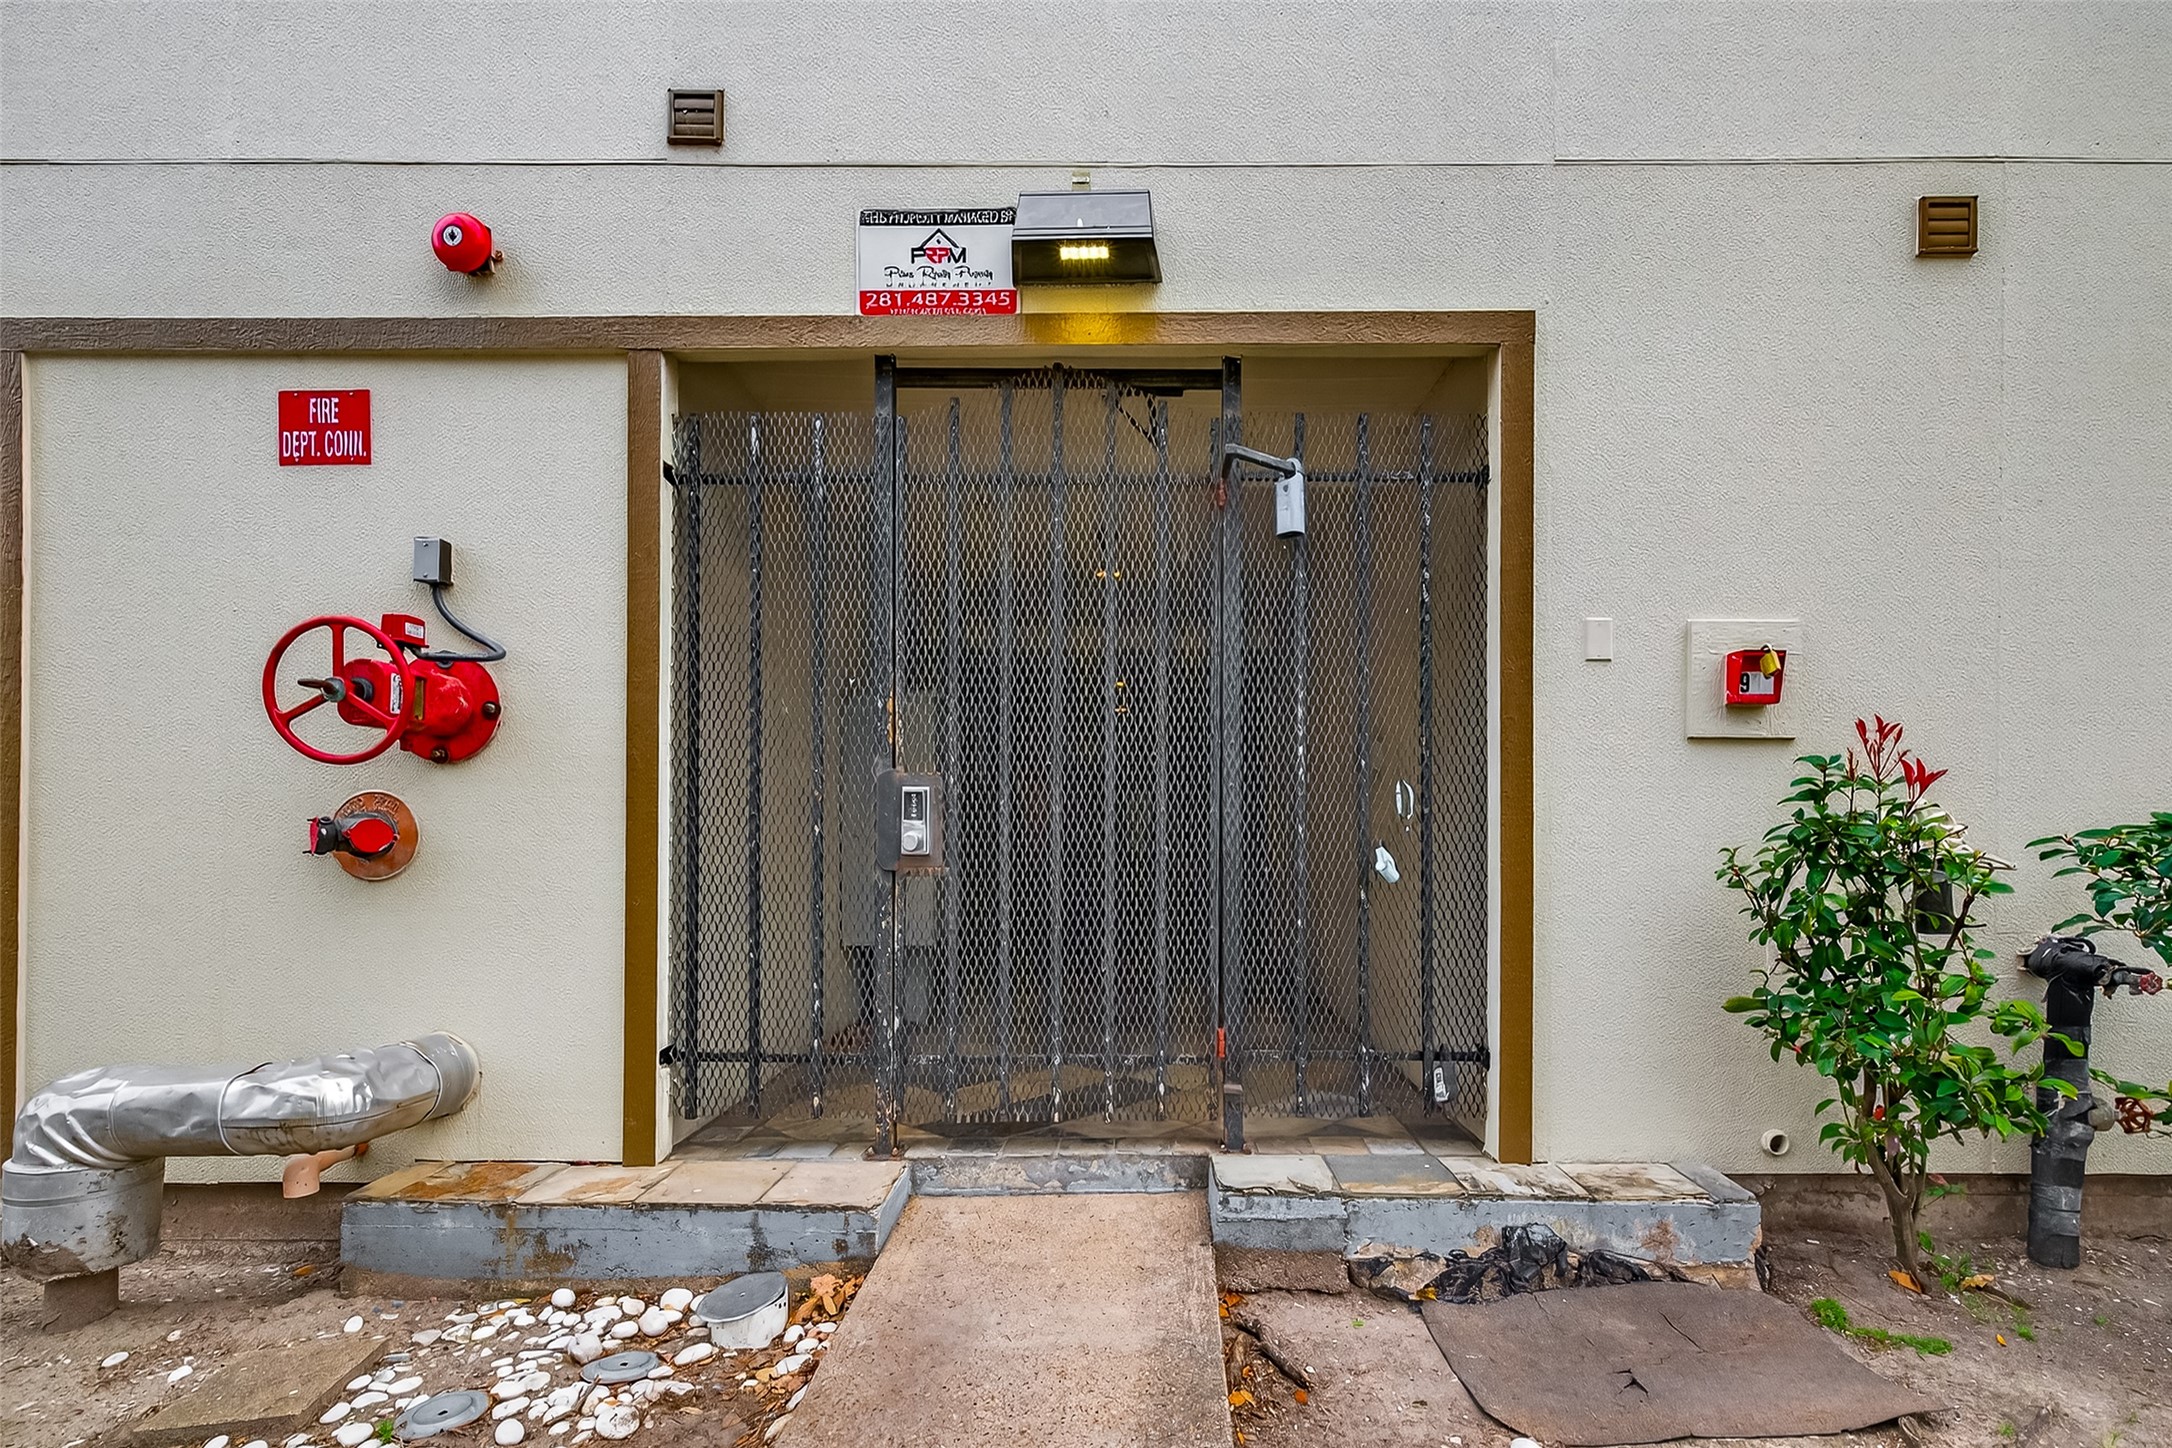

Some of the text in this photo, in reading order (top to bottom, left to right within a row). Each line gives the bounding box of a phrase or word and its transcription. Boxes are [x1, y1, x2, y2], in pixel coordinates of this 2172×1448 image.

[865, 292, 1010, 308] 281.487.3345
[309, 397, 339, 424] FIRE
[283, 430, 366, 457] DEPT. CONN.
